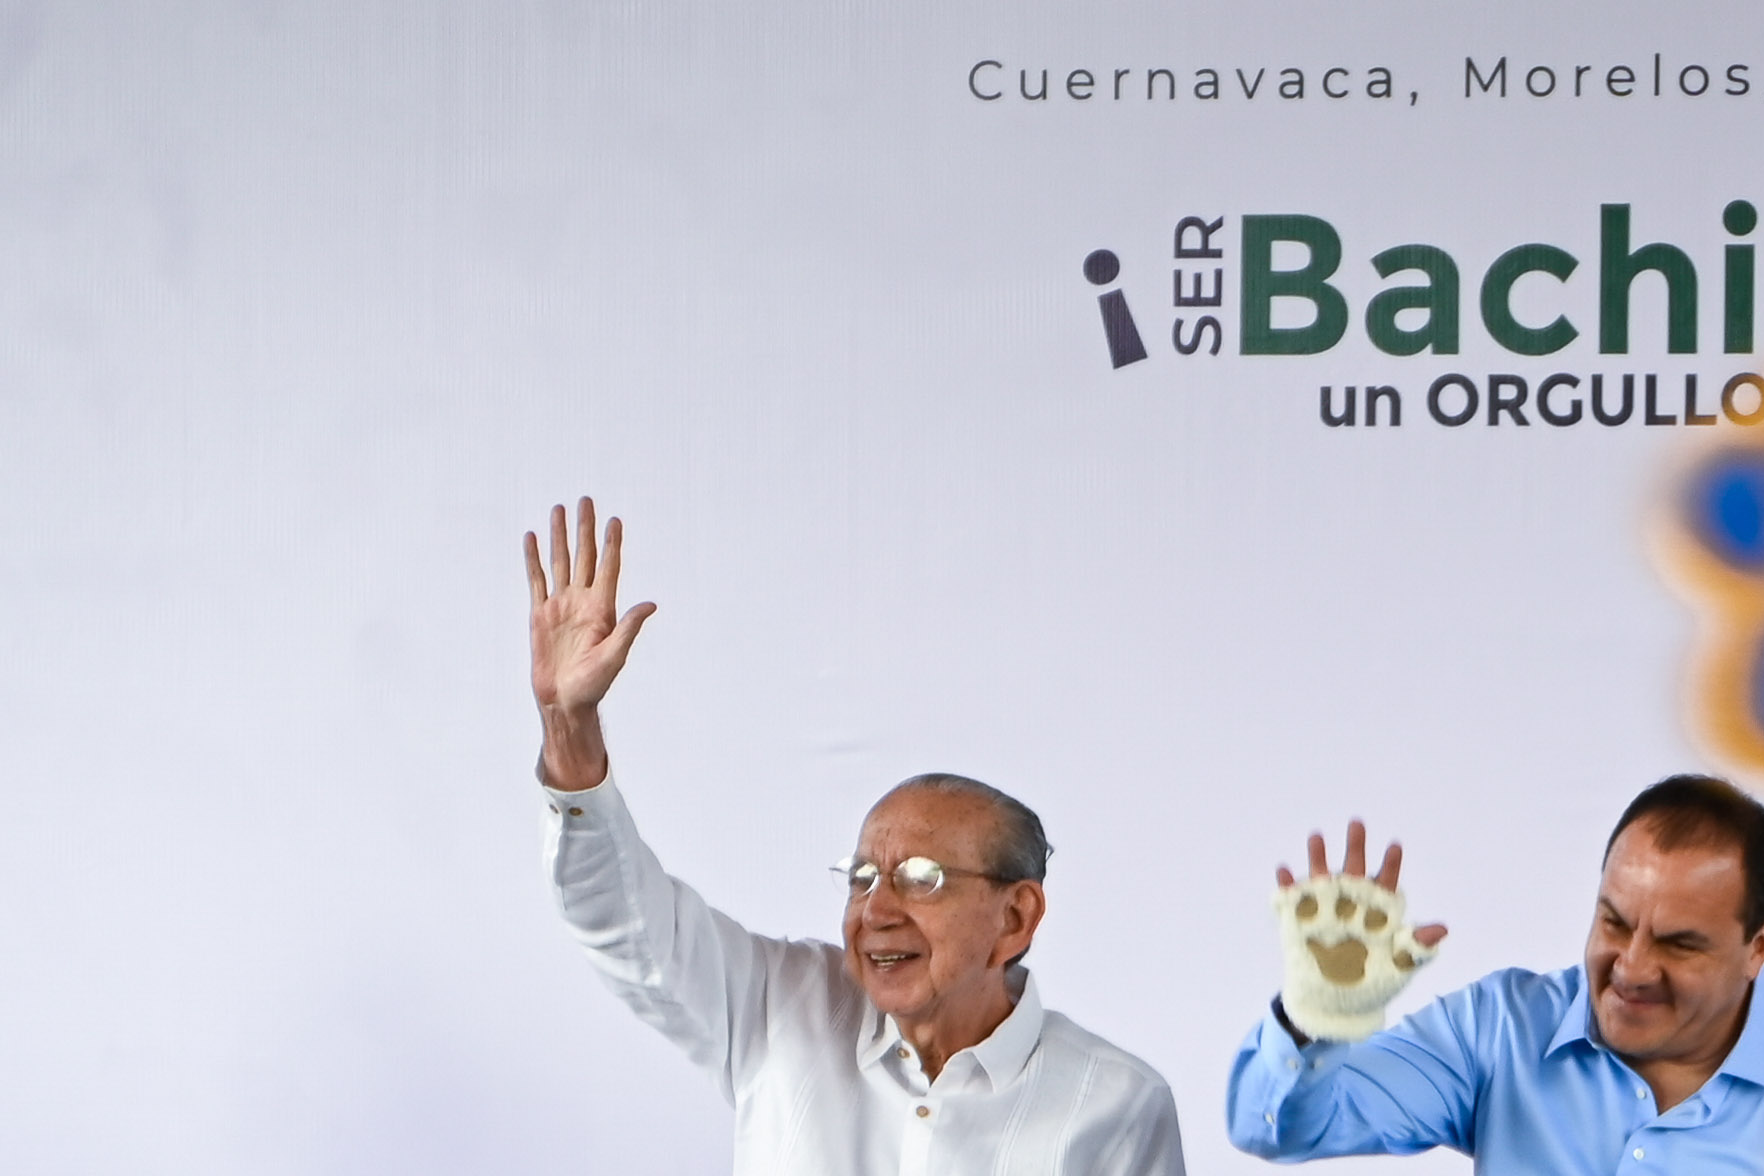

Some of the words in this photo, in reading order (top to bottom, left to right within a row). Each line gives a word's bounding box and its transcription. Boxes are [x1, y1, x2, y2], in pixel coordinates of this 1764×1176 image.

[968, 59, 1419, 107] Cuernavaca,
[1171, 214, 1225, 357] SER
[1319, 384, 1403, 428] un
